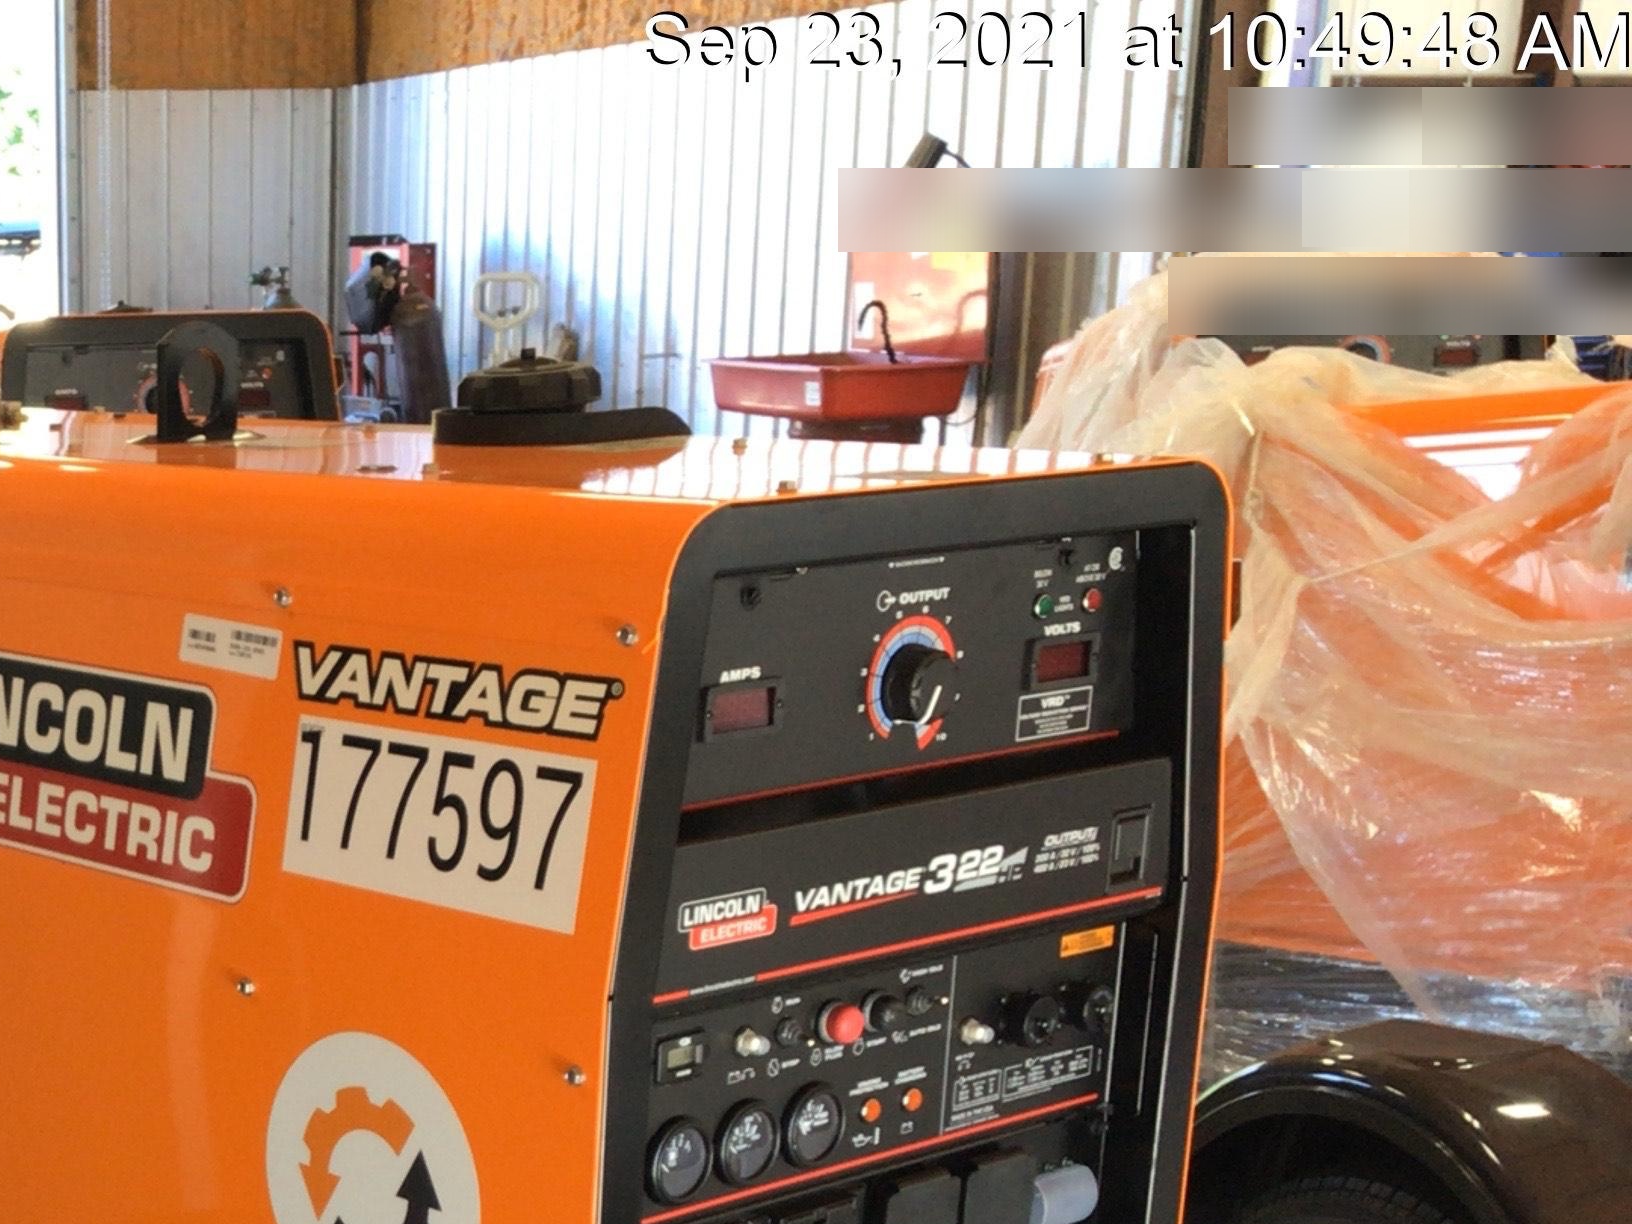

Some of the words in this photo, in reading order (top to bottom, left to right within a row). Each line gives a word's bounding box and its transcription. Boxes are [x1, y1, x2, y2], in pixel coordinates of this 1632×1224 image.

[899, 586, 951, 605] OUTPUT
[1043, 621, 1081, 637] VOLTS
[719, 665, 762, 684] AMPS
[295, 642, 610, 738] VANTAGE
[300, 728, 584, 892] 177597
[794, 866, 924, 913] VANTAGE
[923, 844, 1005, 895] 322
[682, 894, 760, 928] LINCOLN
[699, 917, 768, 944] ELECTRIC
